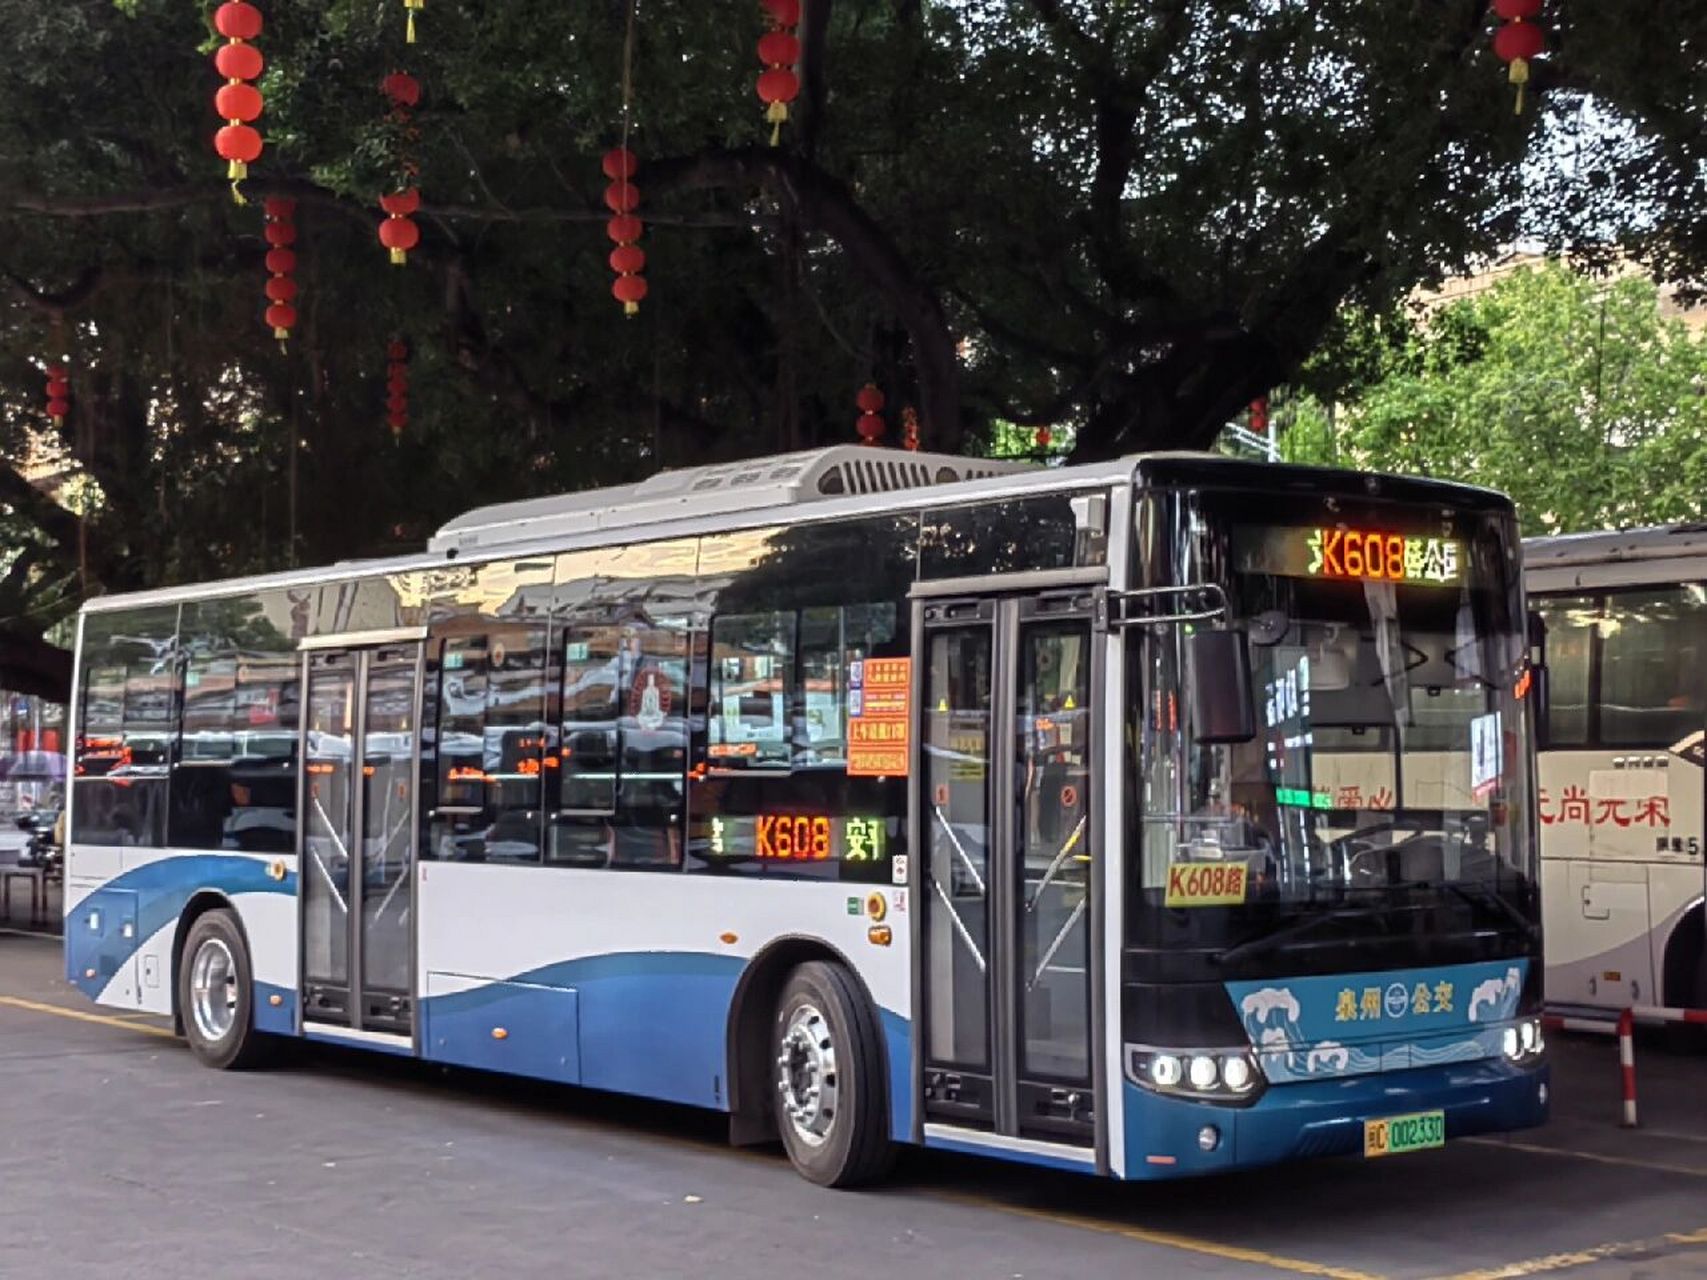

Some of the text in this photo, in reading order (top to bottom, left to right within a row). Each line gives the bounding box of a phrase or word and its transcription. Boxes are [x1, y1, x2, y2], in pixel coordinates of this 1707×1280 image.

[1323, 530, 1404, 579] K608
[756, 815, 831, 859] K608
[1168, 865, 1244, 897] K608路
